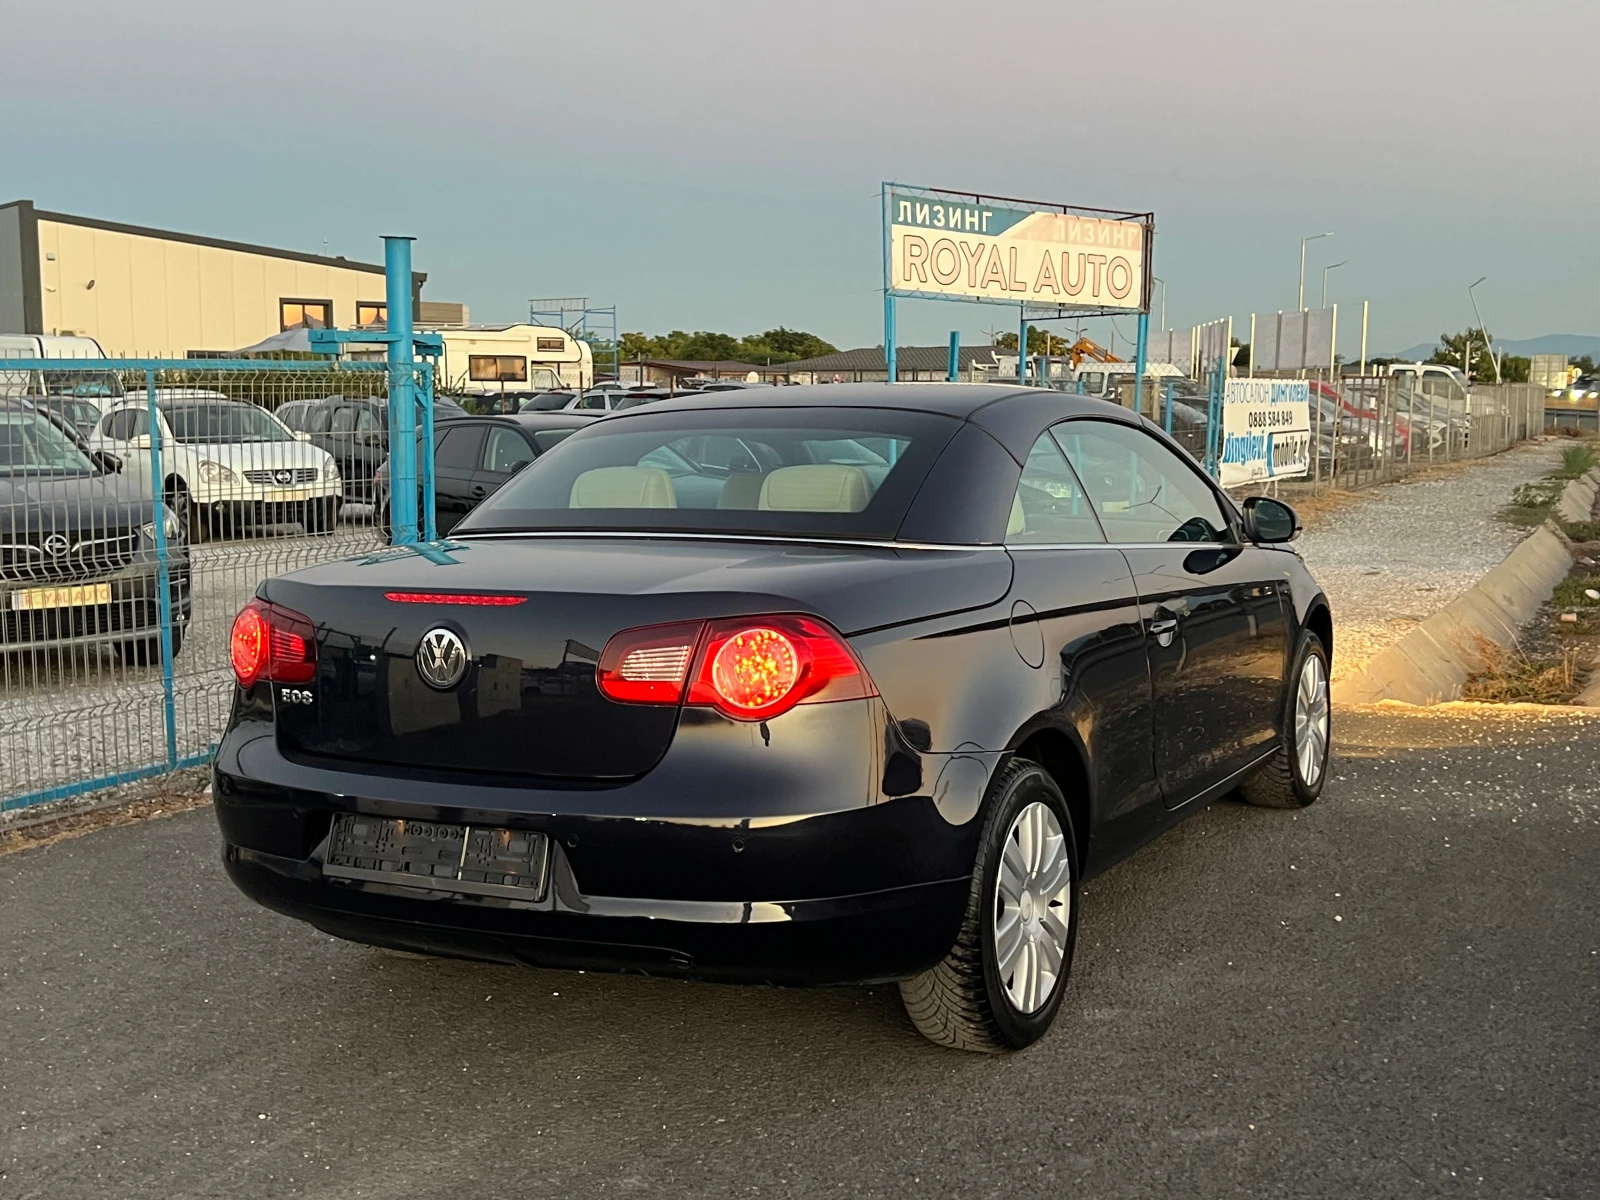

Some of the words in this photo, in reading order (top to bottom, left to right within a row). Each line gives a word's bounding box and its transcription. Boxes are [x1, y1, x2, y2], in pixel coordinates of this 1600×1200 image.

[897, 200, 993, 232] ЛИЗИНГ
[903, 235, 1027, 292] ROYAL
[1033, 250, 1132, 299] AUTO
[1226, 382, 1269, 404] АВТОСАЛОН
[1249, 412, 1267, 427] 0888
[1268, 411, 1280, 426] 584
[1281, 411, 1293, 425] 849
[281, 688, 313, 705] EOS
